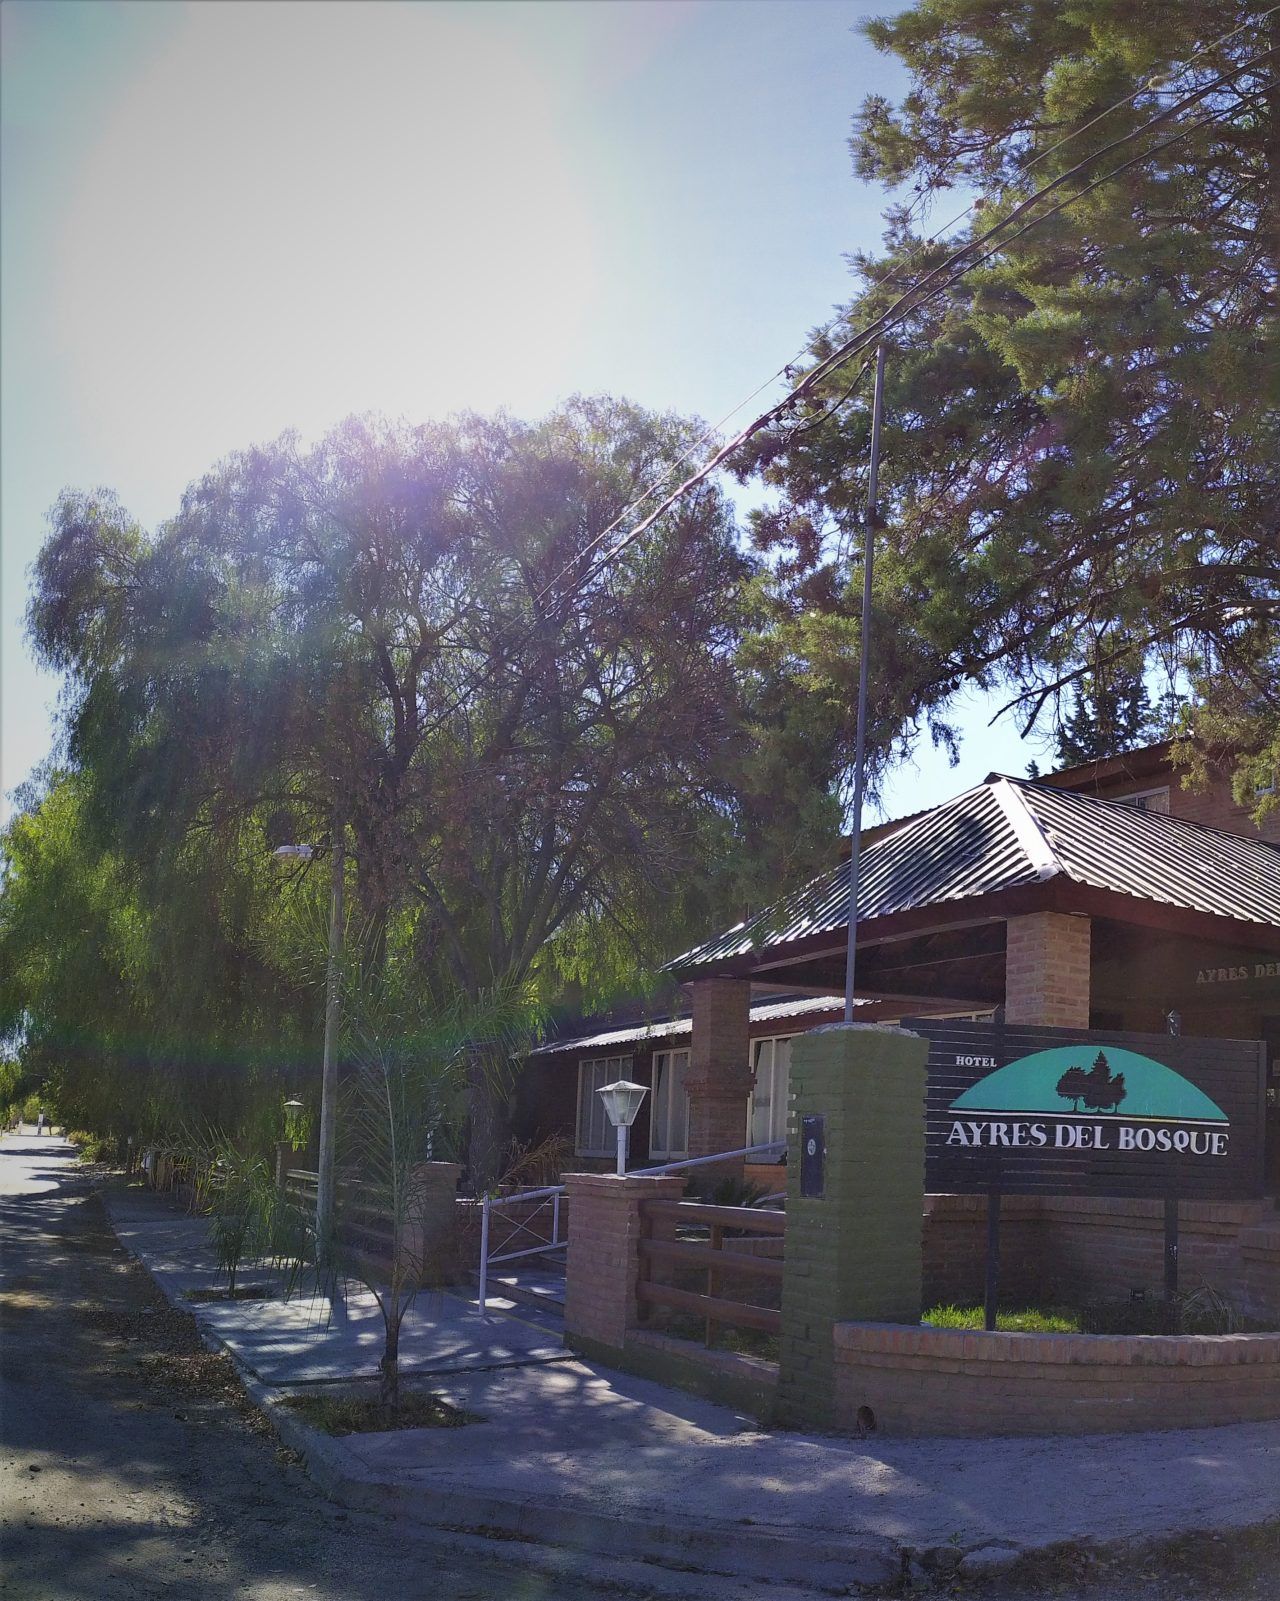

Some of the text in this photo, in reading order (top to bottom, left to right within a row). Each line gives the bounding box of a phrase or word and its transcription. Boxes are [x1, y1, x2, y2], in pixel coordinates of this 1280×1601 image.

[1196, 966, 1249, 985] AYRES
[955, 1055, 998, 1068] HOTEL
[946, 1121, 1230, 1156] AYRES DEL BOSQUE
